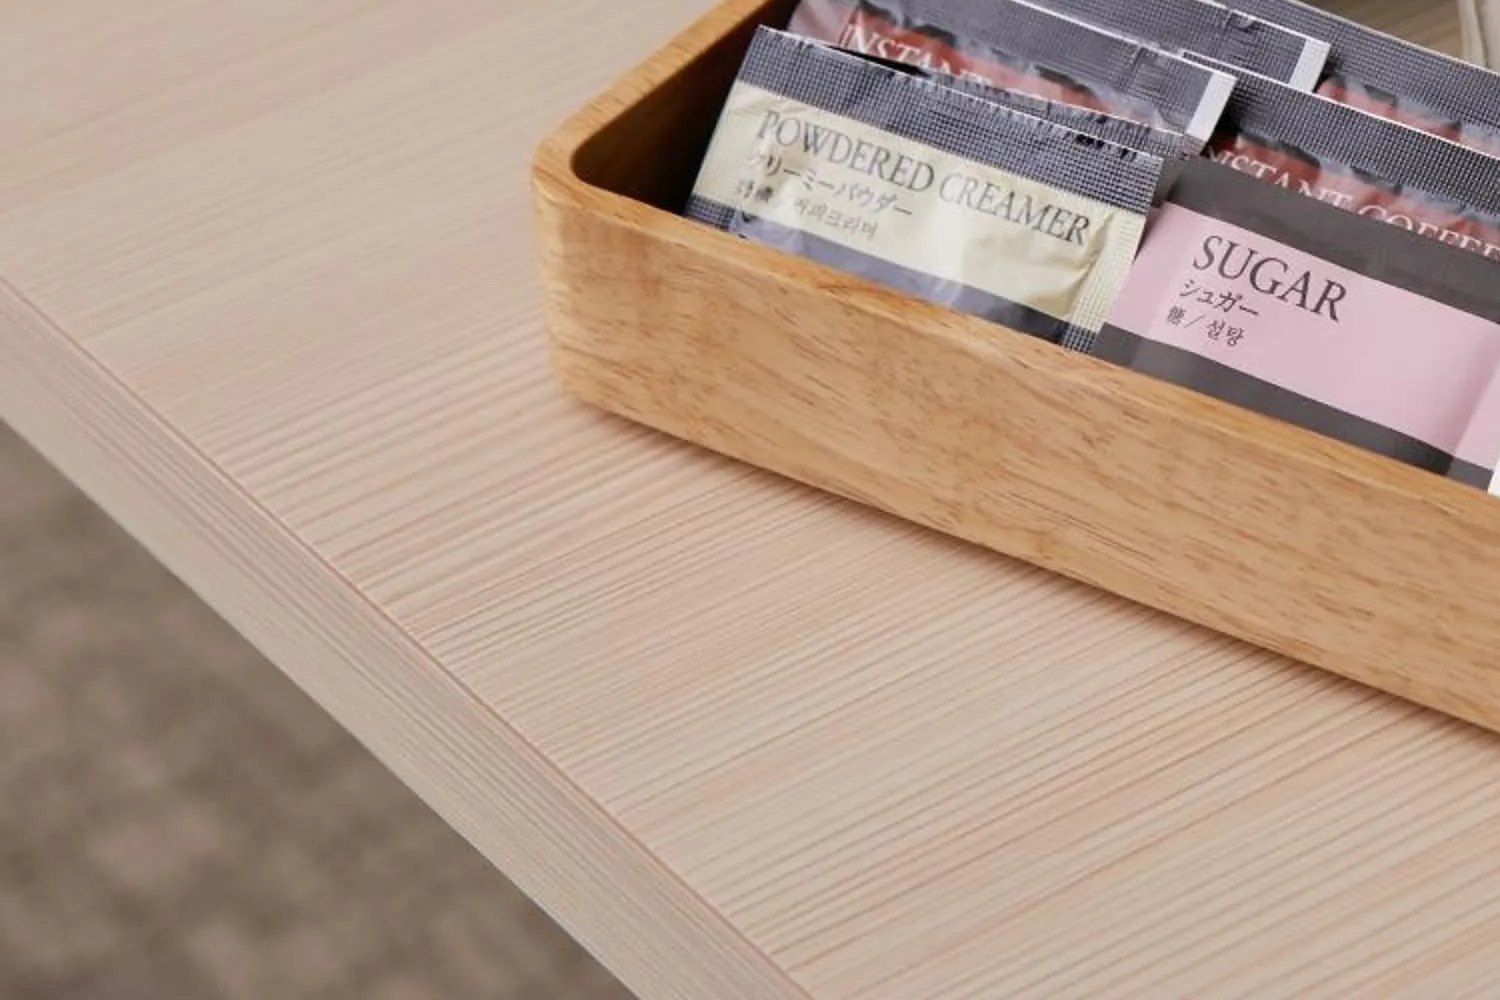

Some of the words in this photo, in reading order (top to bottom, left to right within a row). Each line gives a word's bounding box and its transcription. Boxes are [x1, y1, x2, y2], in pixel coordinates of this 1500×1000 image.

[757, 110, 936, 192] POWDERED
[938, 172, 1090, 247] CREAMER
[1179, 279, 1258, 315] シュガー
[1193, 234, 1347, 324] SUGAR
